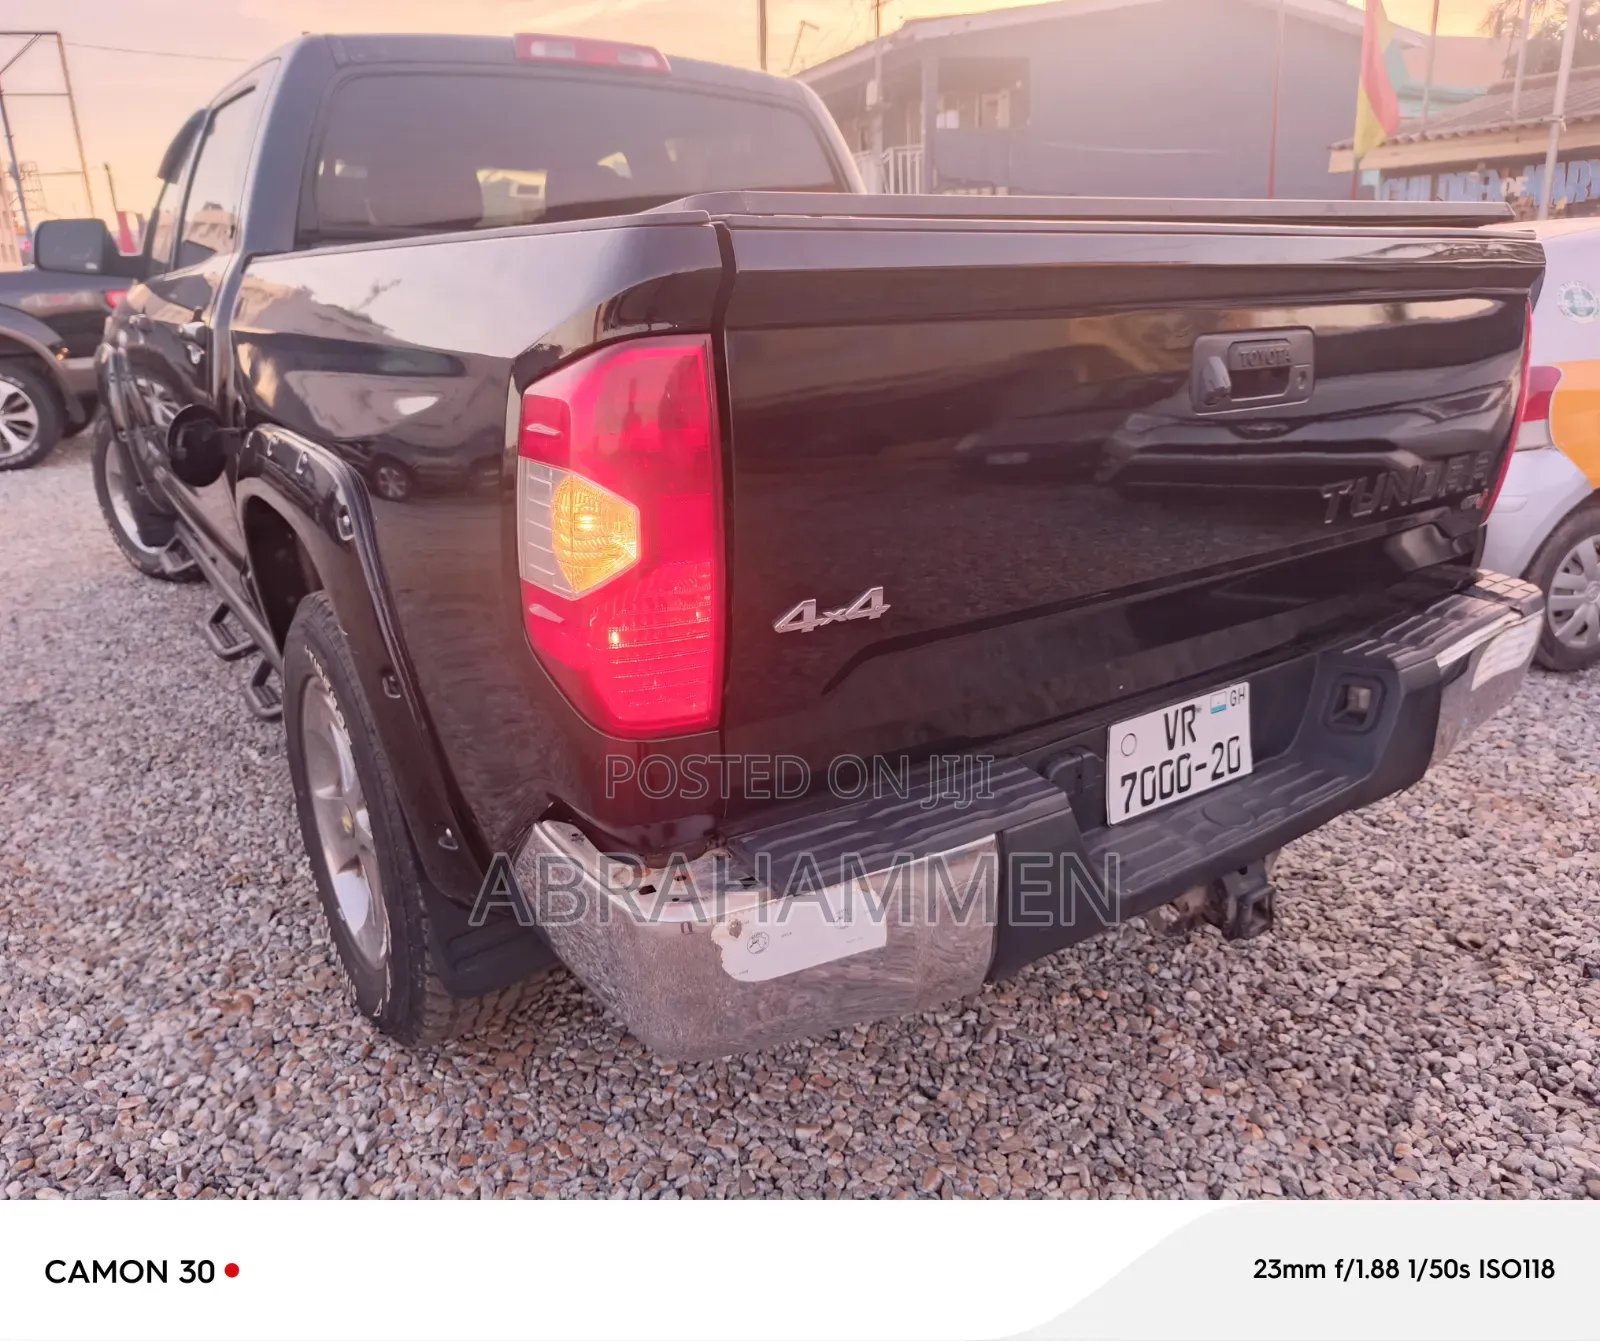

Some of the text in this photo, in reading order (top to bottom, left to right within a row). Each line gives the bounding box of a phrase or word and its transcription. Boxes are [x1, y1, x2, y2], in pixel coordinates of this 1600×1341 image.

[1239, 347, 1292, 368] TOYOTA
[1164, 687, 1246, 751] VR GH
[1120, 735, 1241, 814] 7000-20
